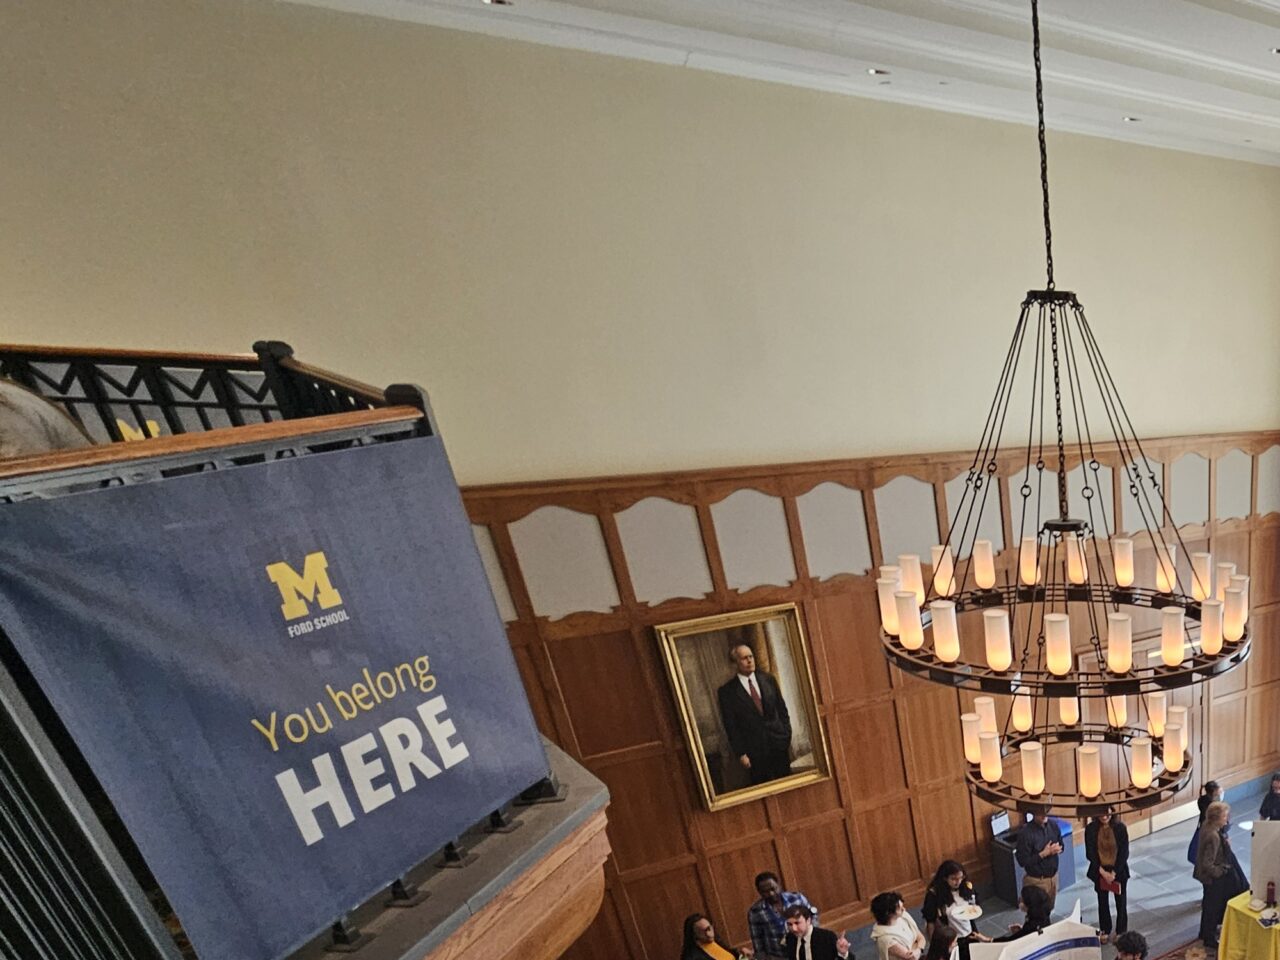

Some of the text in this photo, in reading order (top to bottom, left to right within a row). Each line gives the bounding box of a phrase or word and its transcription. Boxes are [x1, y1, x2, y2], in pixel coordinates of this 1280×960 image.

[266, 551, 343, 621] M
[287, 609, 350, 638] FORD SCHOOL
[251, 655, 437, 752] You belong
[274, 694, 470, 847] HERE
